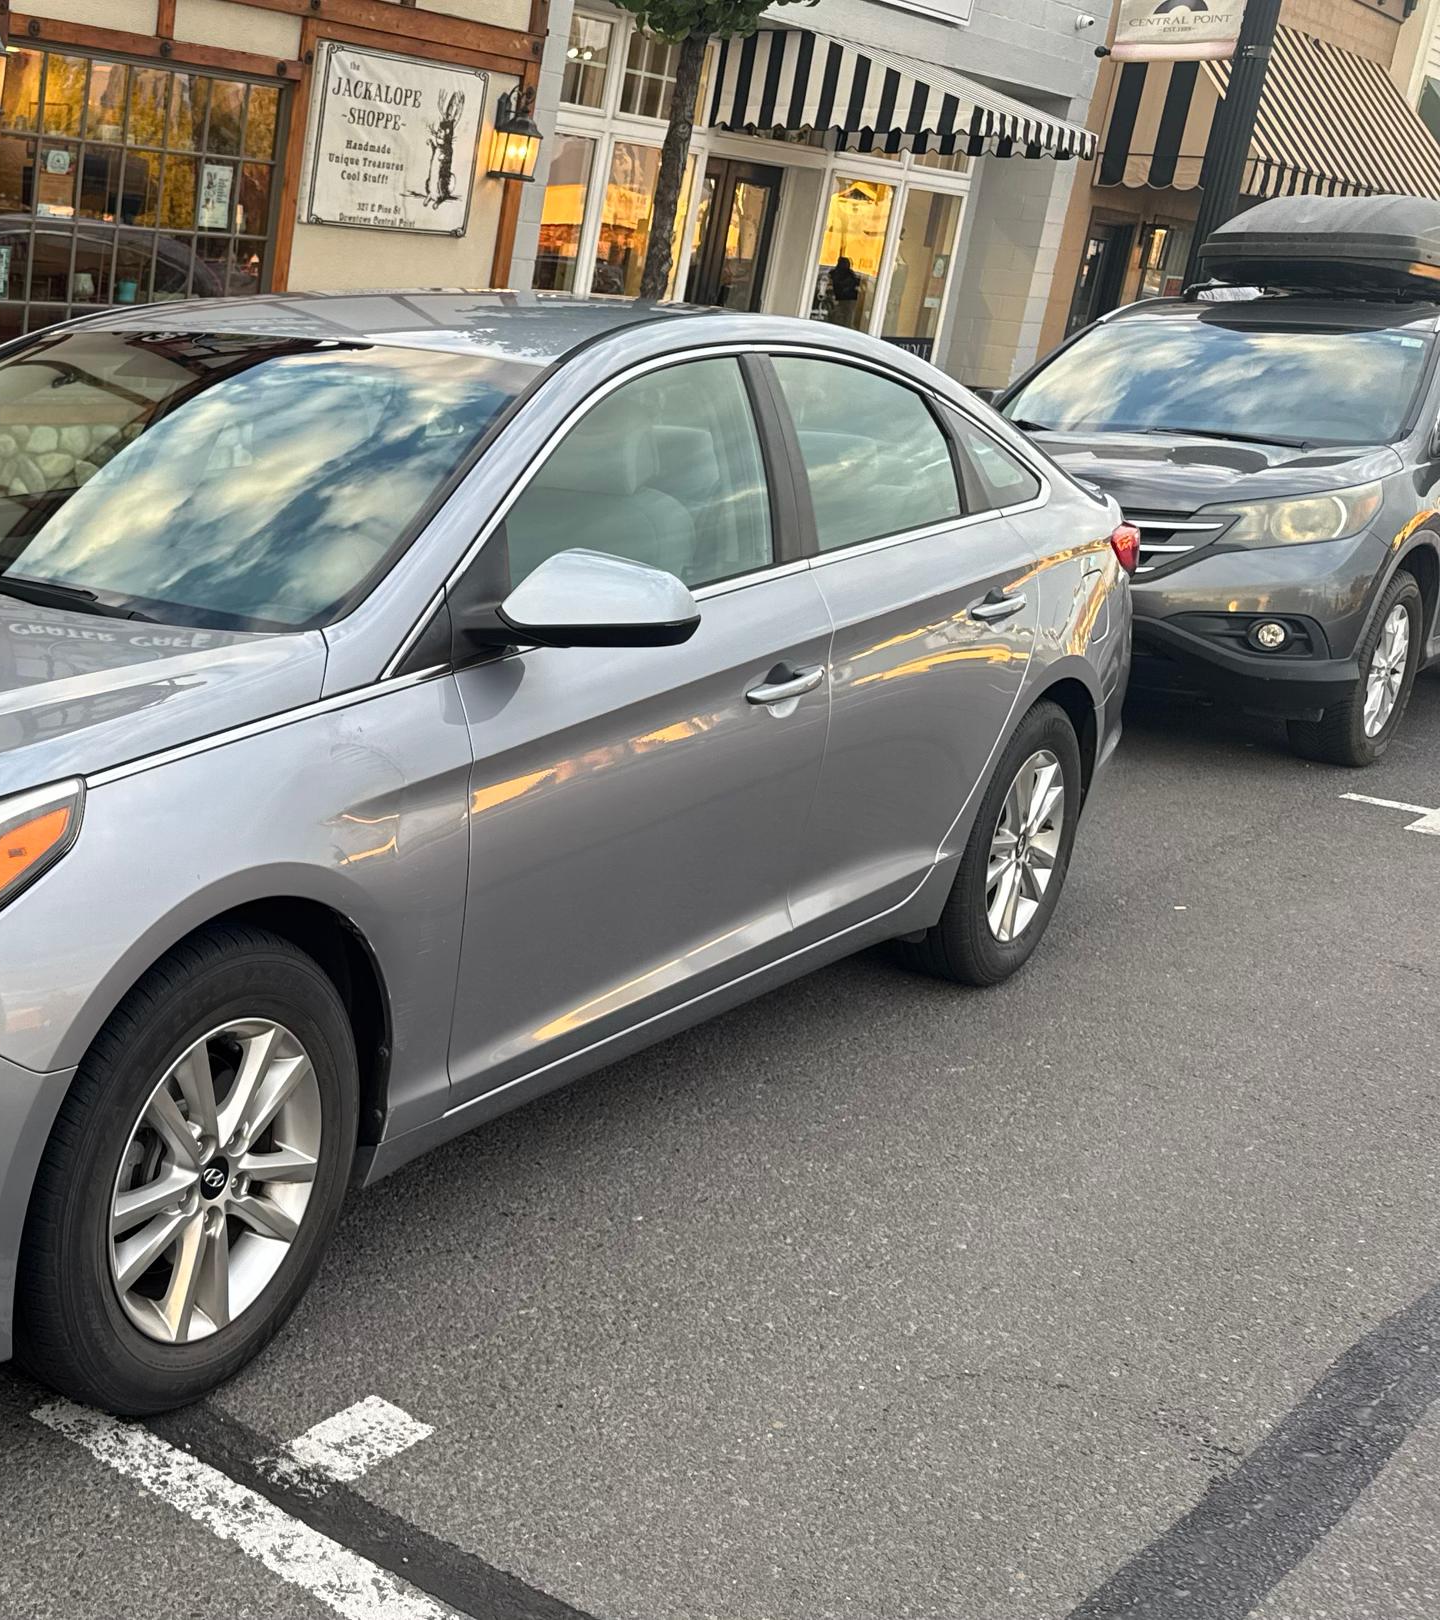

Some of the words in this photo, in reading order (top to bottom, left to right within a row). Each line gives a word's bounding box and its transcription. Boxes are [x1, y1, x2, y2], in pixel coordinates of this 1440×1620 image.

[1129, 15, 1189, 27] CENTRAL
[1192, 14, 1233, 24] POINT
[349, 61, 361, 71] the
[332, 77, 422, 109] JACKALOPE
[345, 140, 391, 154] Handmade
[328, 152, 359, 166] Unique
[363, 157, 404, 171] Treasures
[341, 170, 360, 182] Cool
[362, 172, 389, 184] Stuff!
[377, 204, 391, 214] Pine
[339, 212, 371, 224] Downtown
[372, 215, 397, 226] Central
[398, 217, 415, 228] Point
